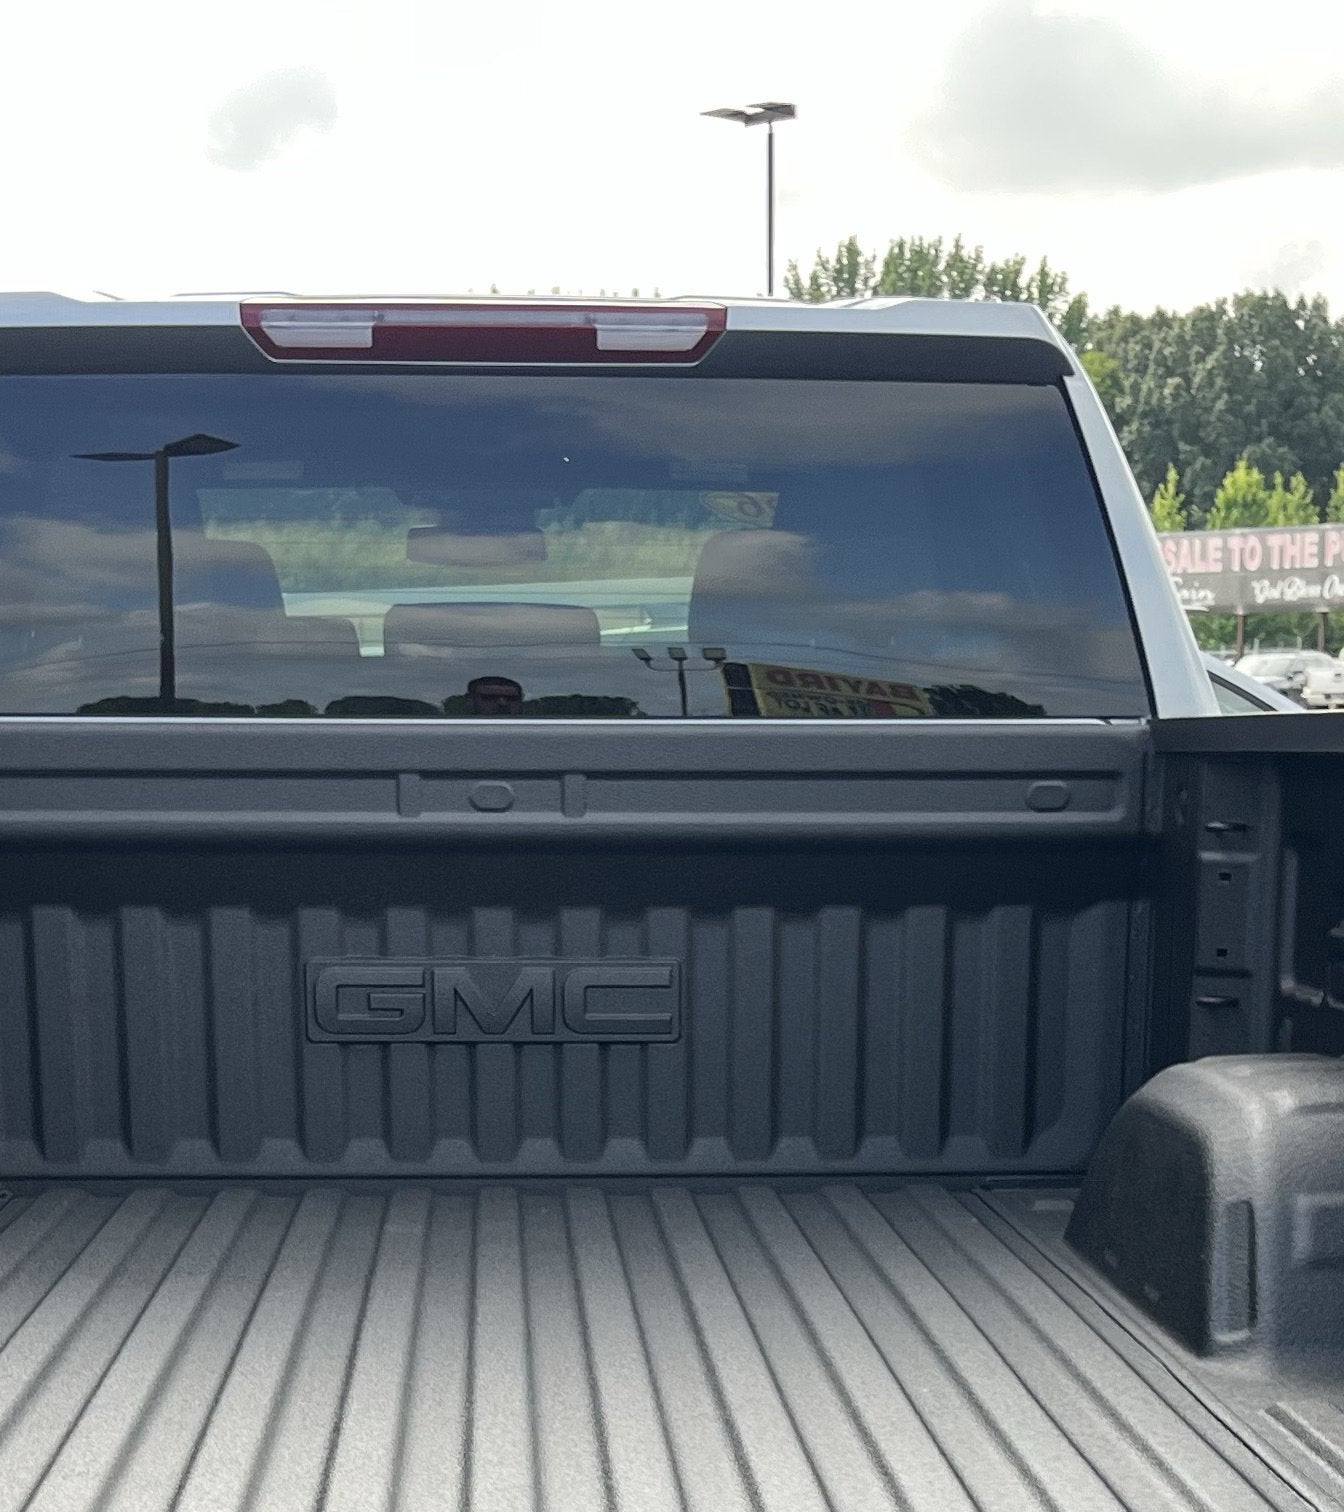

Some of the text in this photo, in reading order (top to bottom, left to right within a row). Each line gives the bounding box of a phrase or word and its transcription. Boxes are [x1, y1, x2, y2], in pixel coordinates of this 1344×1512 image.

[1227, 534, 1263, 572] TO
[1266, 531, 1320, 570] THE
[314, 965, 673, 1035] GMC
